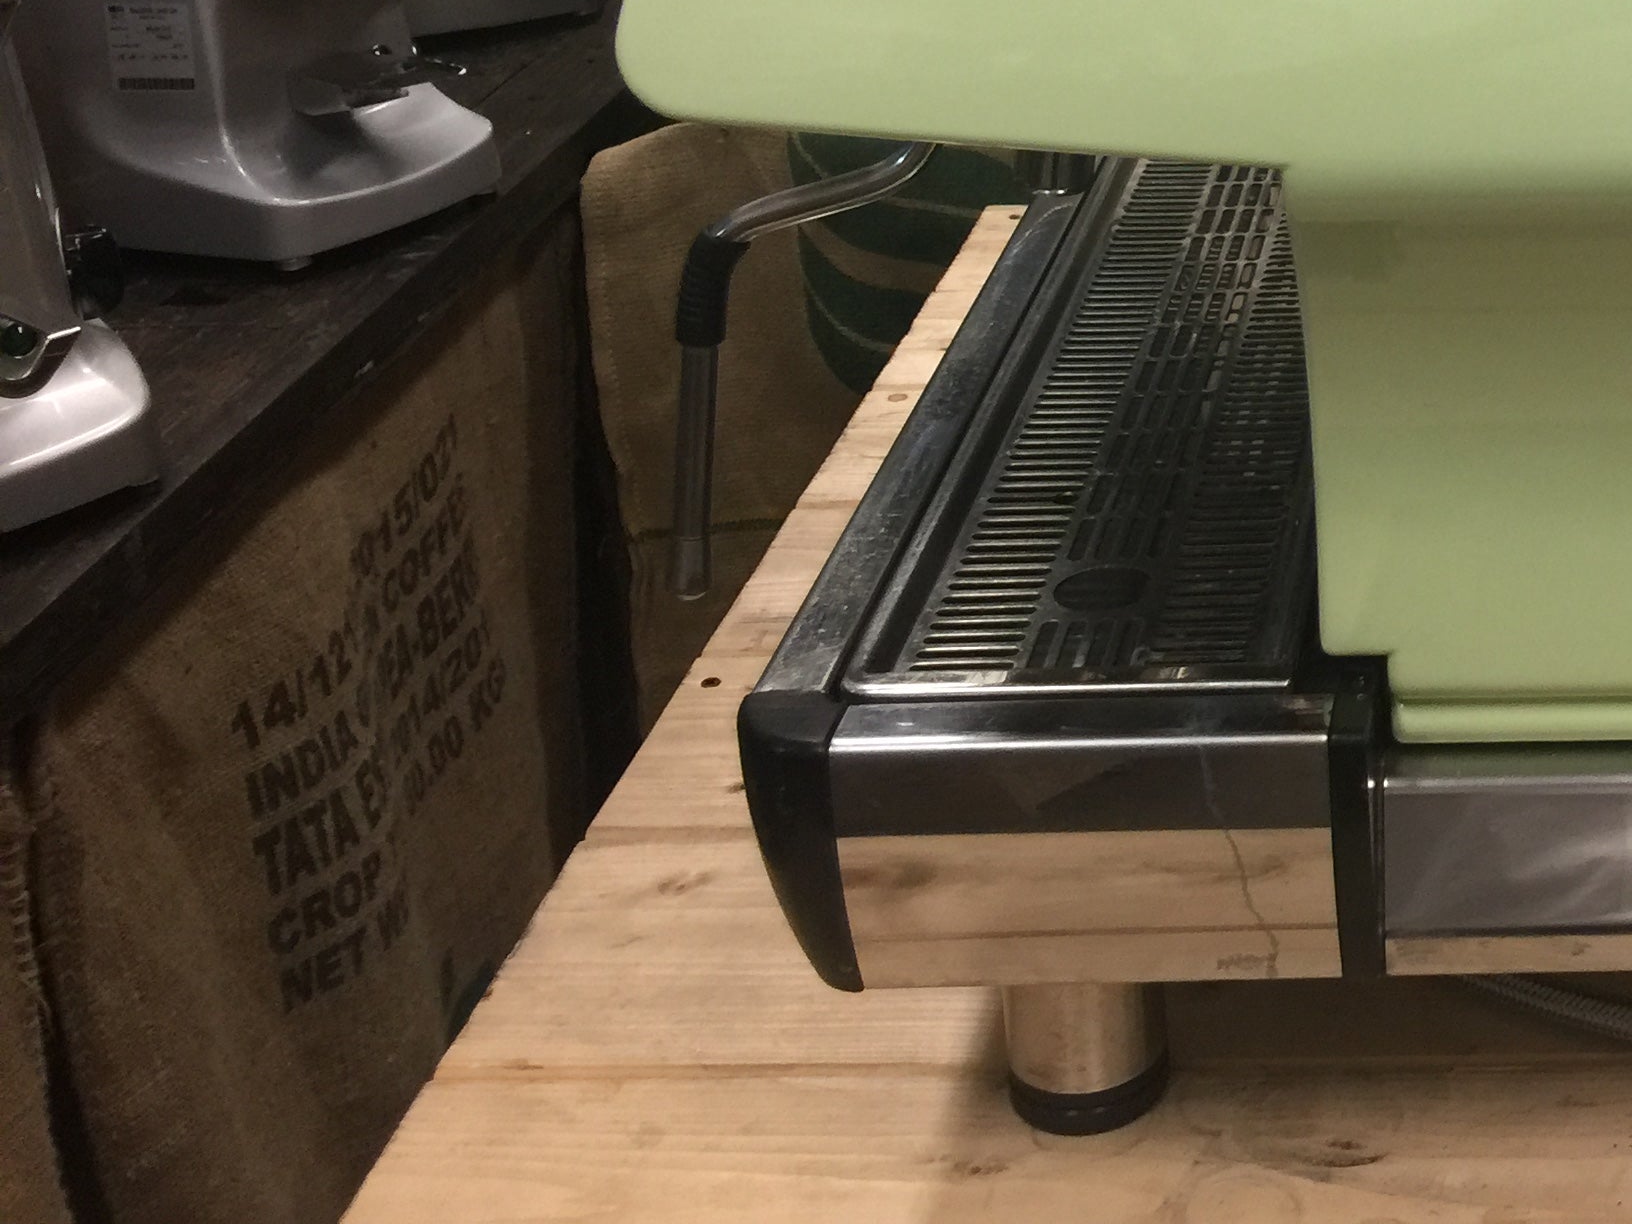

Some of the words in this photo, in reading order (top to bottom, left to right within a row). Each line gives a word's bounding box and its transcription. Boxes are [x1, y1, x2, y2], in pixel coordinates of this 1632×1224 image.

[246, 709, 359, 821] INDIA
[252, 788, 361, 896] TATA
[267, 849, 382, 957] CROP
